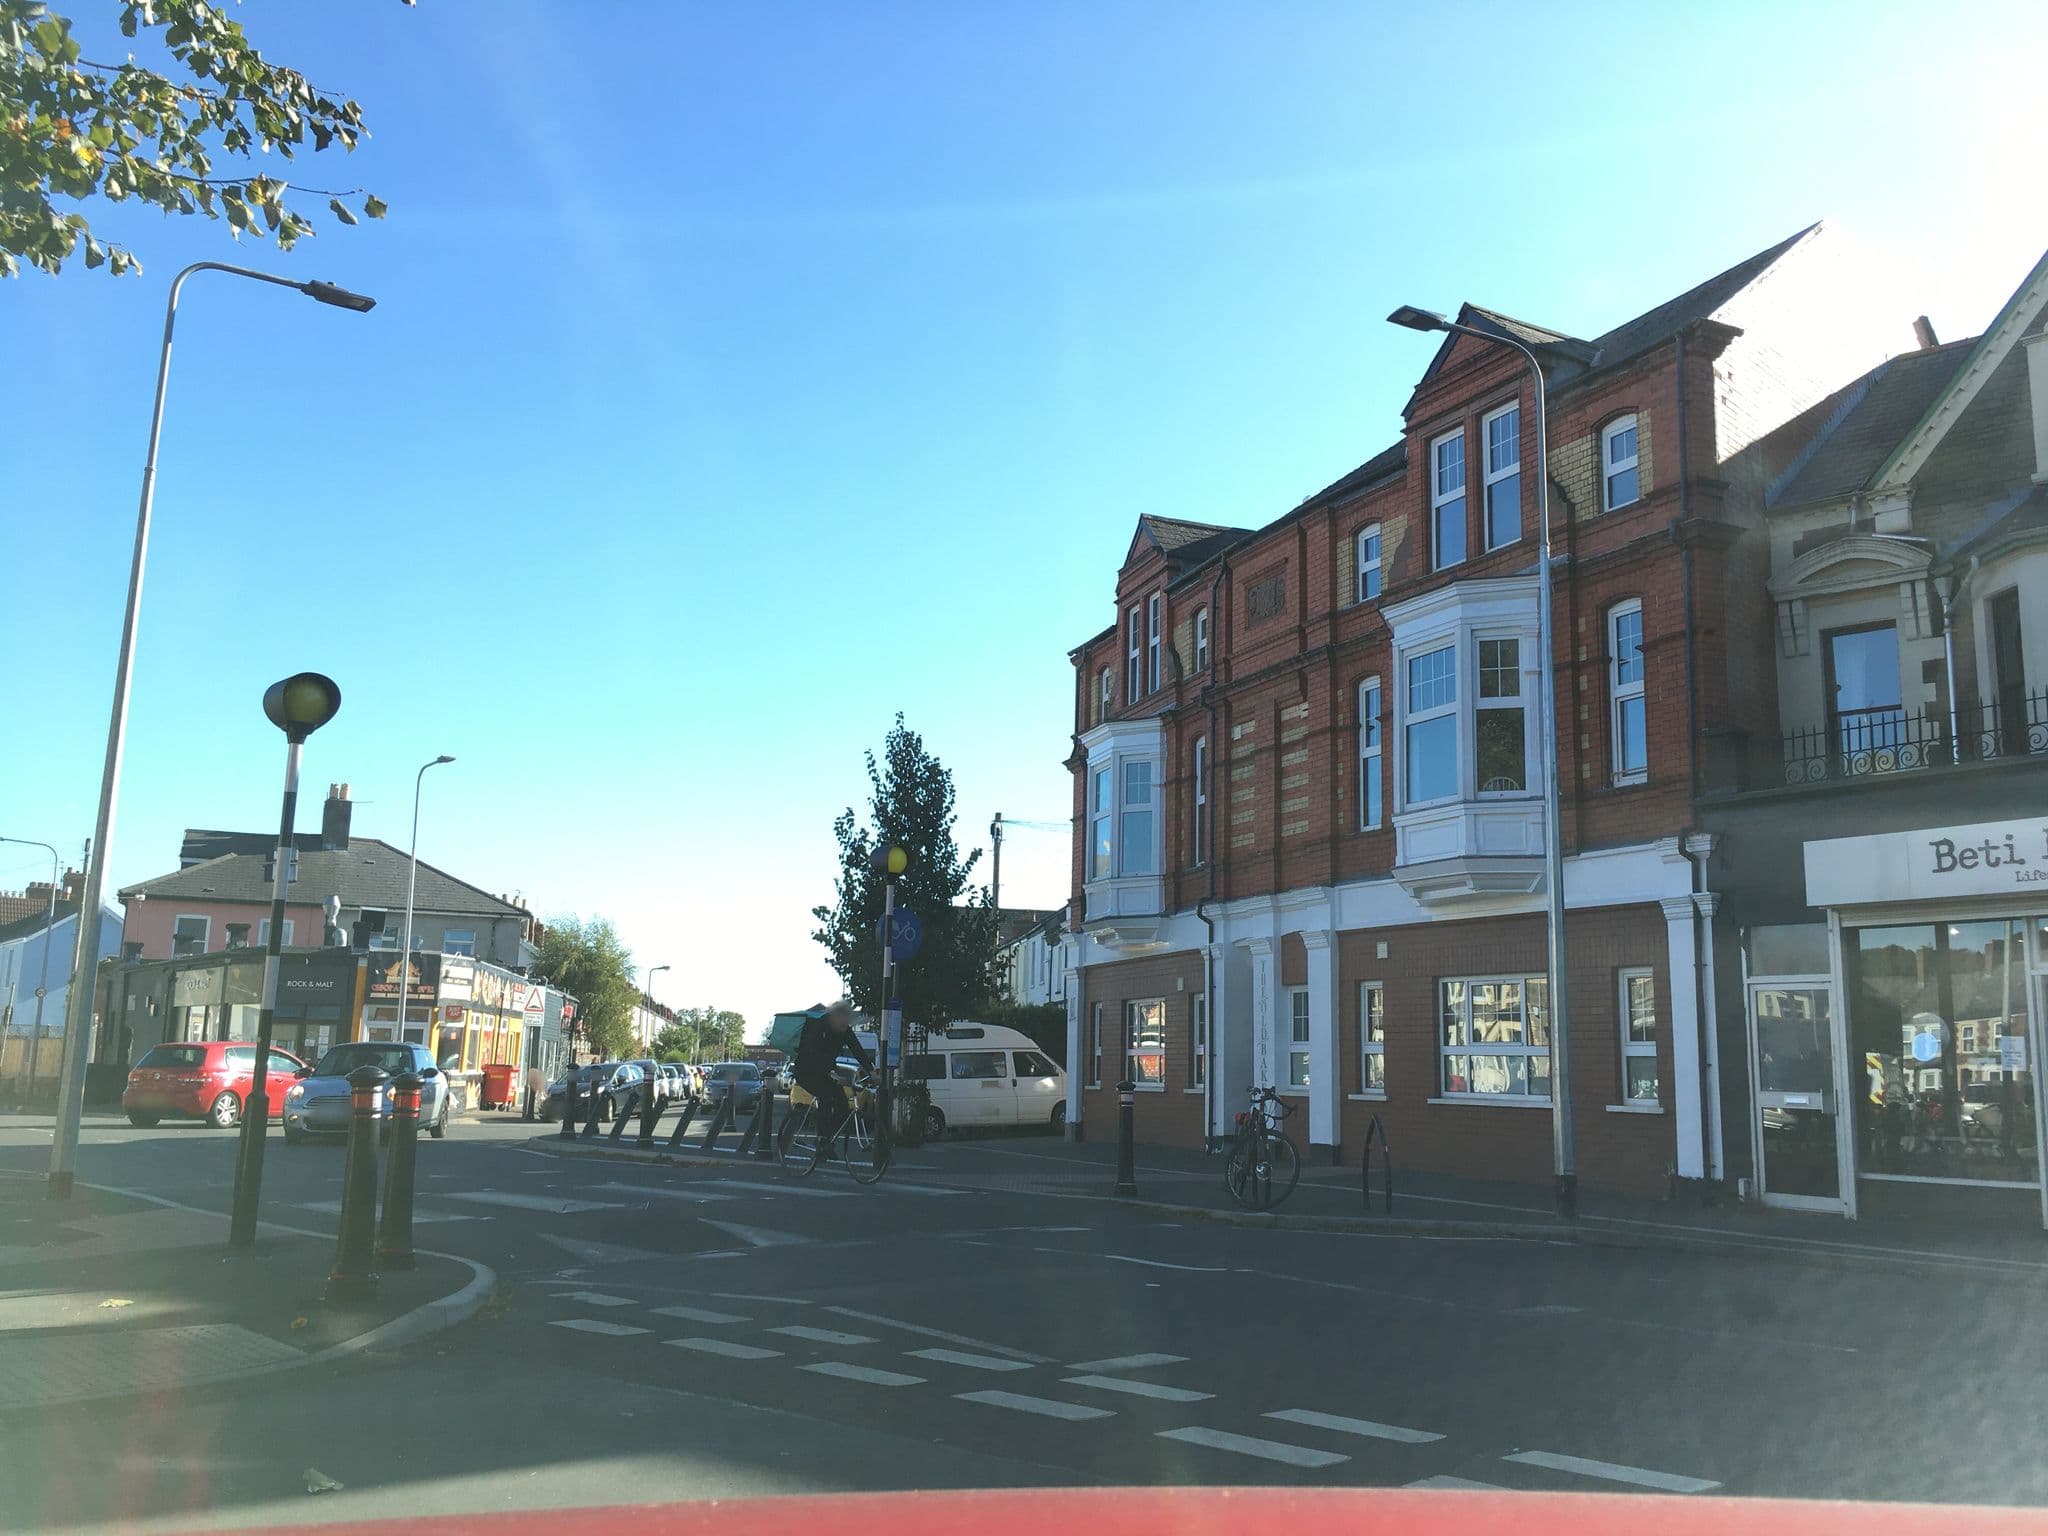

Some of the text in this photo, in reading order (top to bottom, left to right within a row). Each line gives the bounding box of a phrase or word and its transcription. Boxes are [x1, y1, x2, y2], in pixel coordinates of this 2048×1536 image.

[1929, 834, 2026, 873] Beti
[2015, 869, 2048, 882] Life
[308, 980, 314, 988] &
